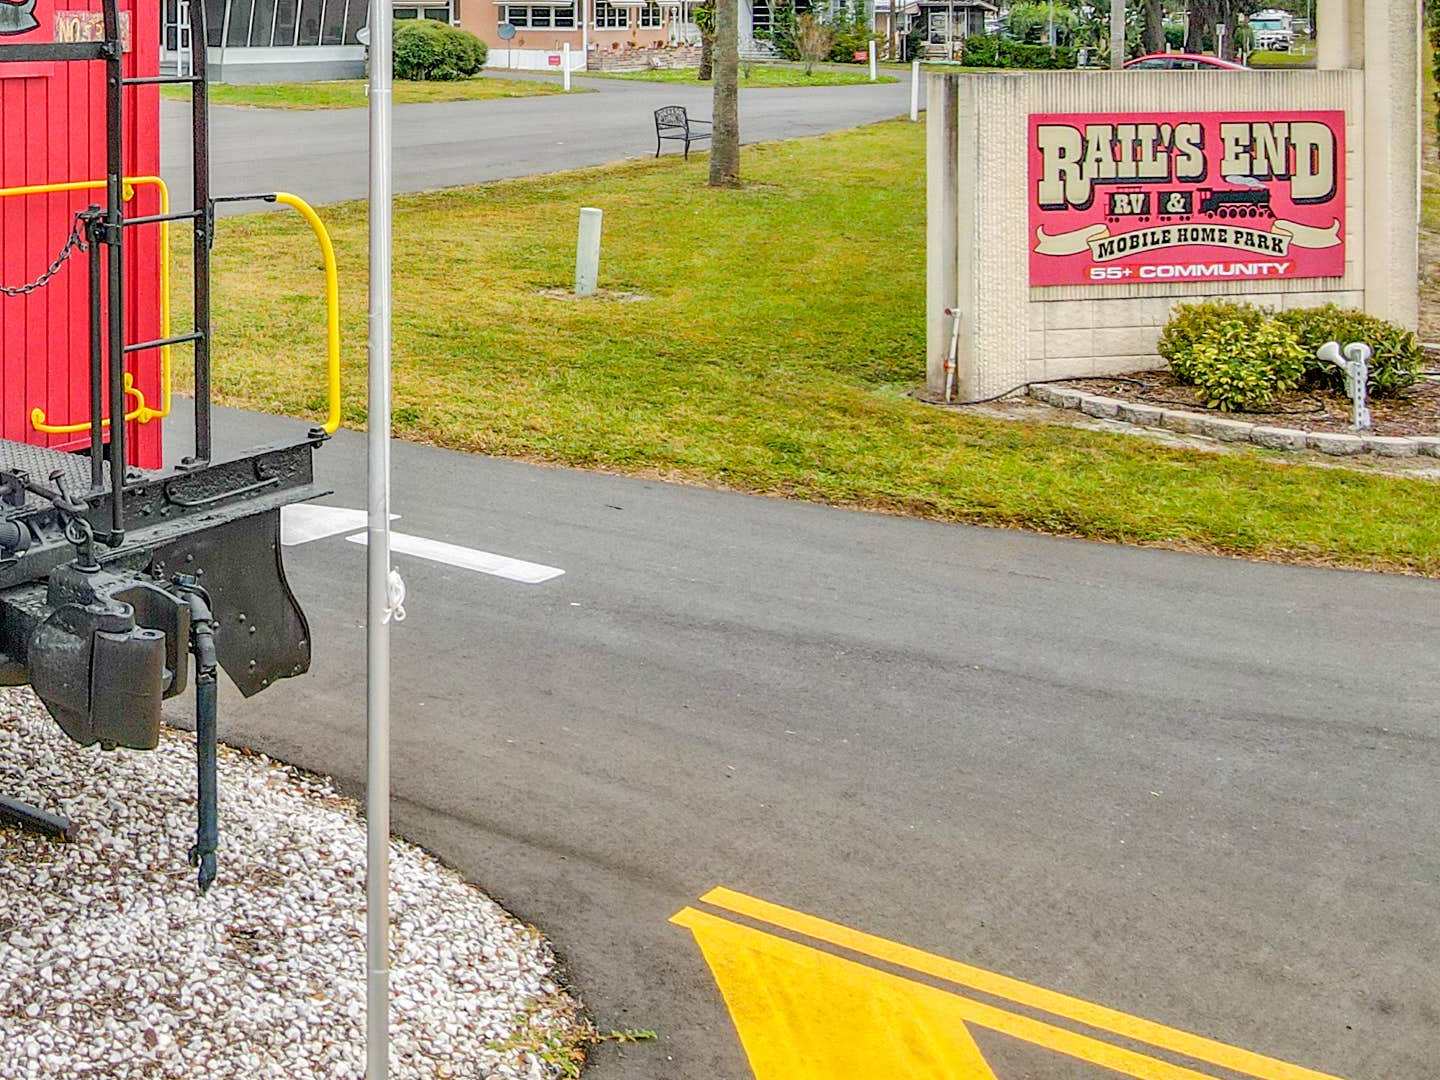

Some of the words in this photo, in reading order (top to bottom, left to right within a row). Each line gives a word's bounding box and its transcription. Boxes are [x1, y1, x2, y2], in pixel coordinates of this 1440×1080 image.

[1037, 123, 1207, 210] RAIL'S
[1220, 121, 1338, 204] END
[1114, 191, 1146, 215] RV
[1166, 191, 1187, 215] &
[1098, 229, 1171, 259] MOBILE
[1177, 227, 1228, 243] HOME
[1233, 230, 1284, 254] PARK
[1090, 266, 1133, 280] 55+
[1139, 262, 1290, 278] COMMUNITY
